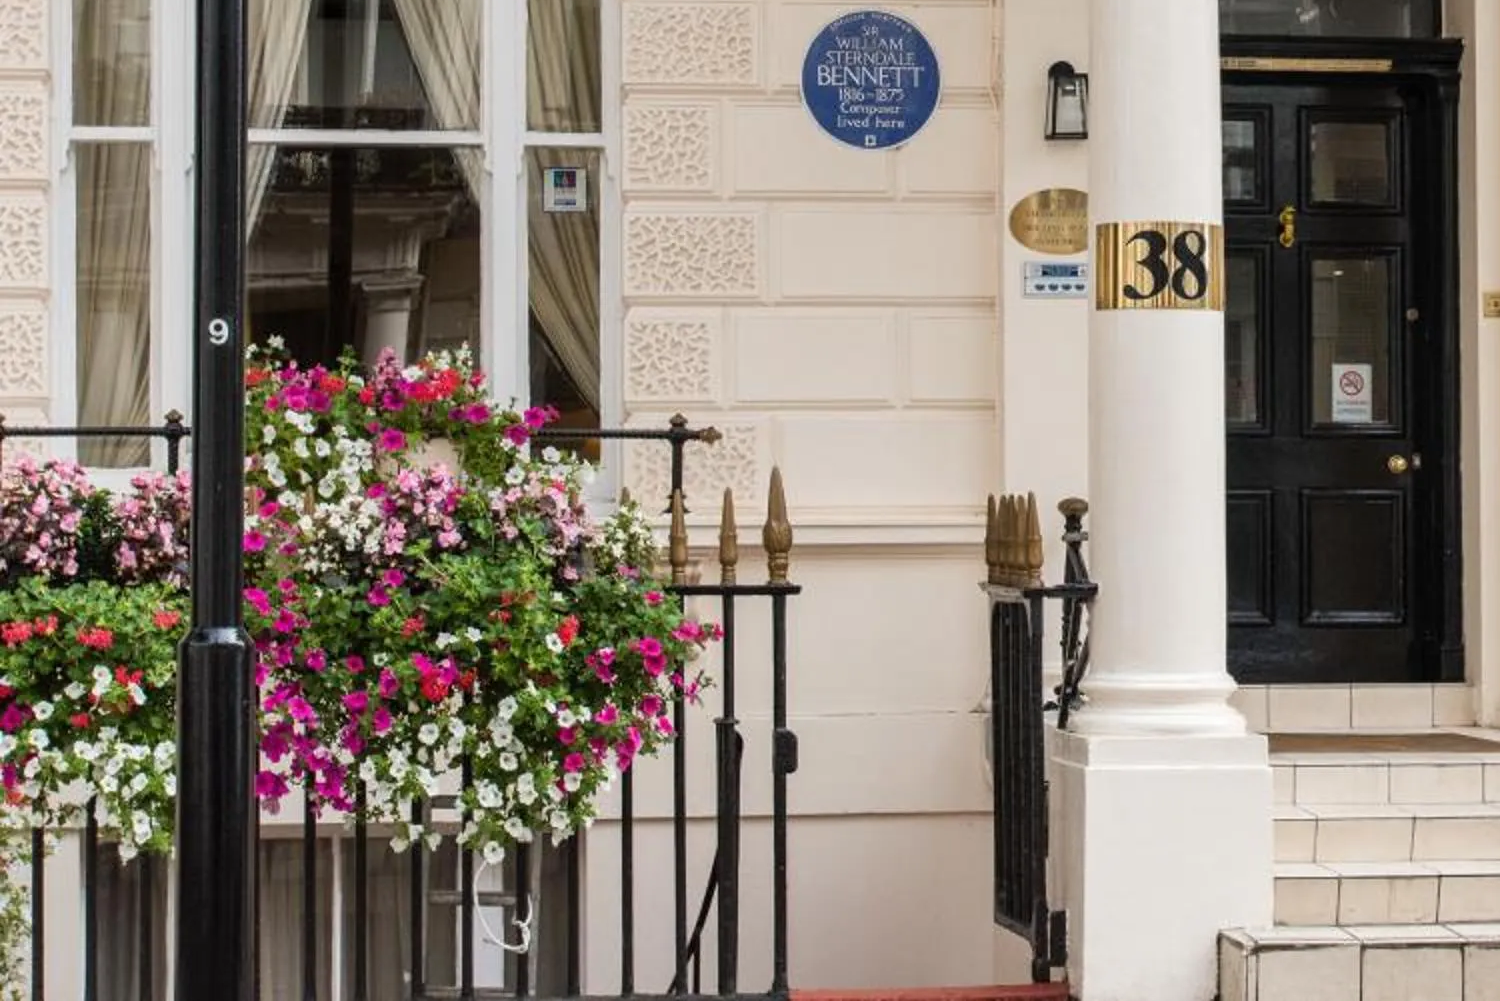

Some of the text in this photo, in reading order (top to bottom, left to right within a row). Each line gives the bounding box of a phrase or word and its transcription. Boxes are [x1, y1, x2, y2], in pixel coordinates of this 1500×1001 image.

[835, 37, 904, 51] WILLIAM
[825, 50, 916, 65] STERNDALE
[817, 66, 925, 88] BENNETT
[839, 102, 901, 115] Composer
[1122, 229, 1208, 301] 38
[208, 318, 229, 346] 9
